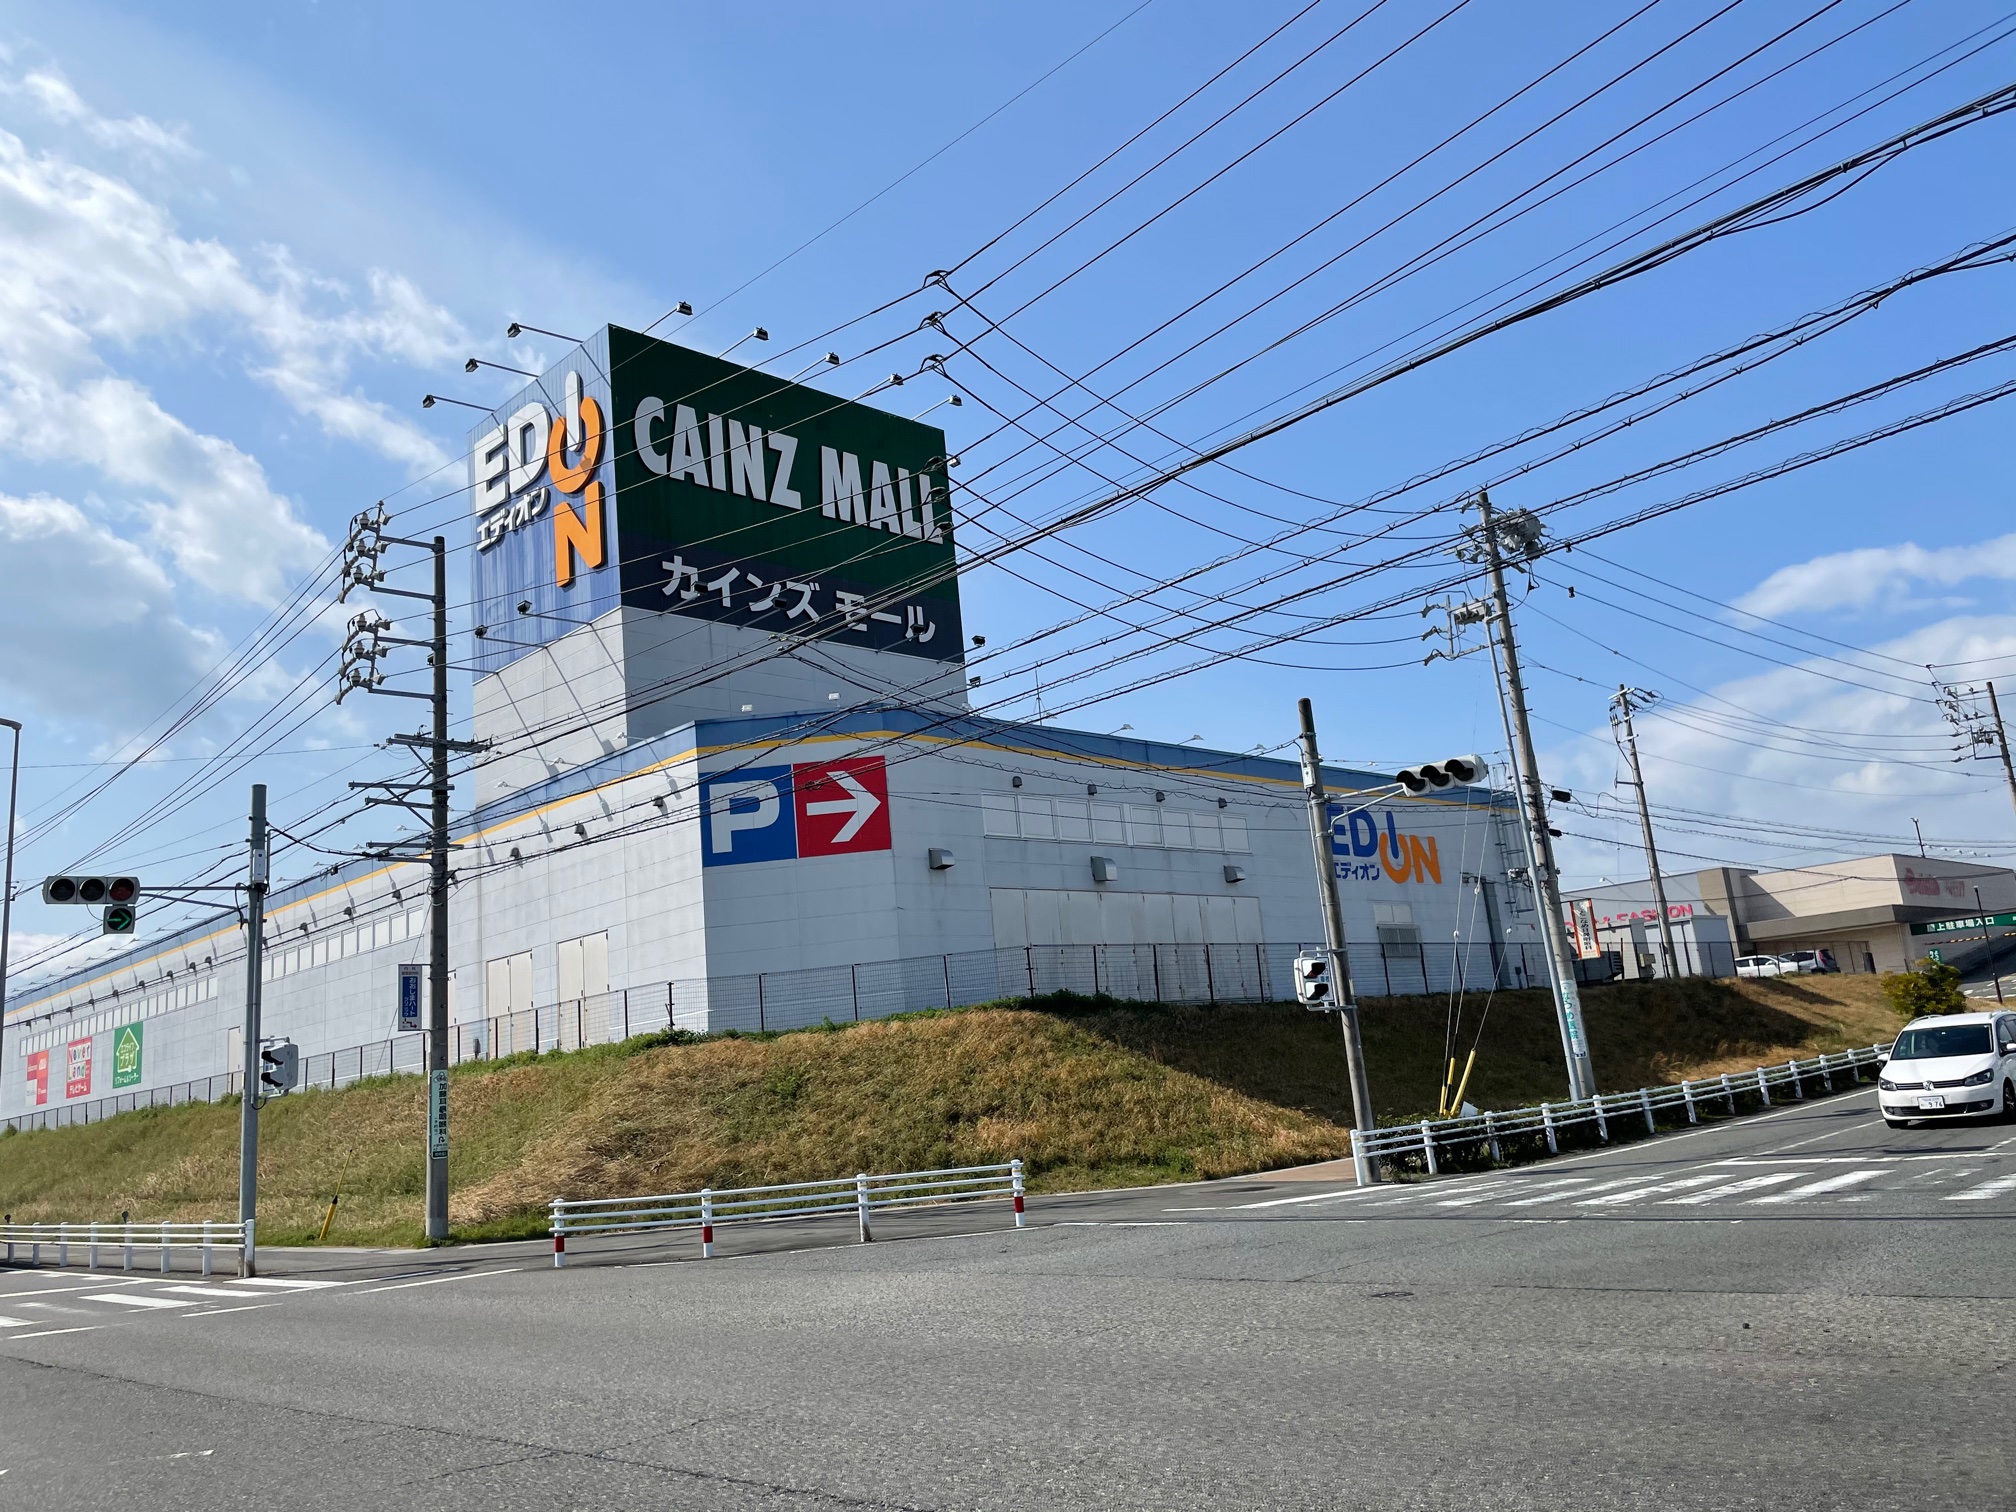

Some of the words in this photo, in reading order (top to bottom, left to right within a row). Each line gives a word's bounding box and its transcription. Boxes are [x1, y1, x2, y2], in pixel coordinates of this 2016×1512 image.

[474, 370, 602, 588] EDION
[635, 396, 801, 510] CAINZ
[821, 445, 944, 545] MALL
[476, 487, 549, 551] エディオン
[662, 555, 821, 622] カインズ
[836, 590, 936, 643] モール
[709, 779, 780, 854] P
[1326, 805, 1443, 885] EDION
